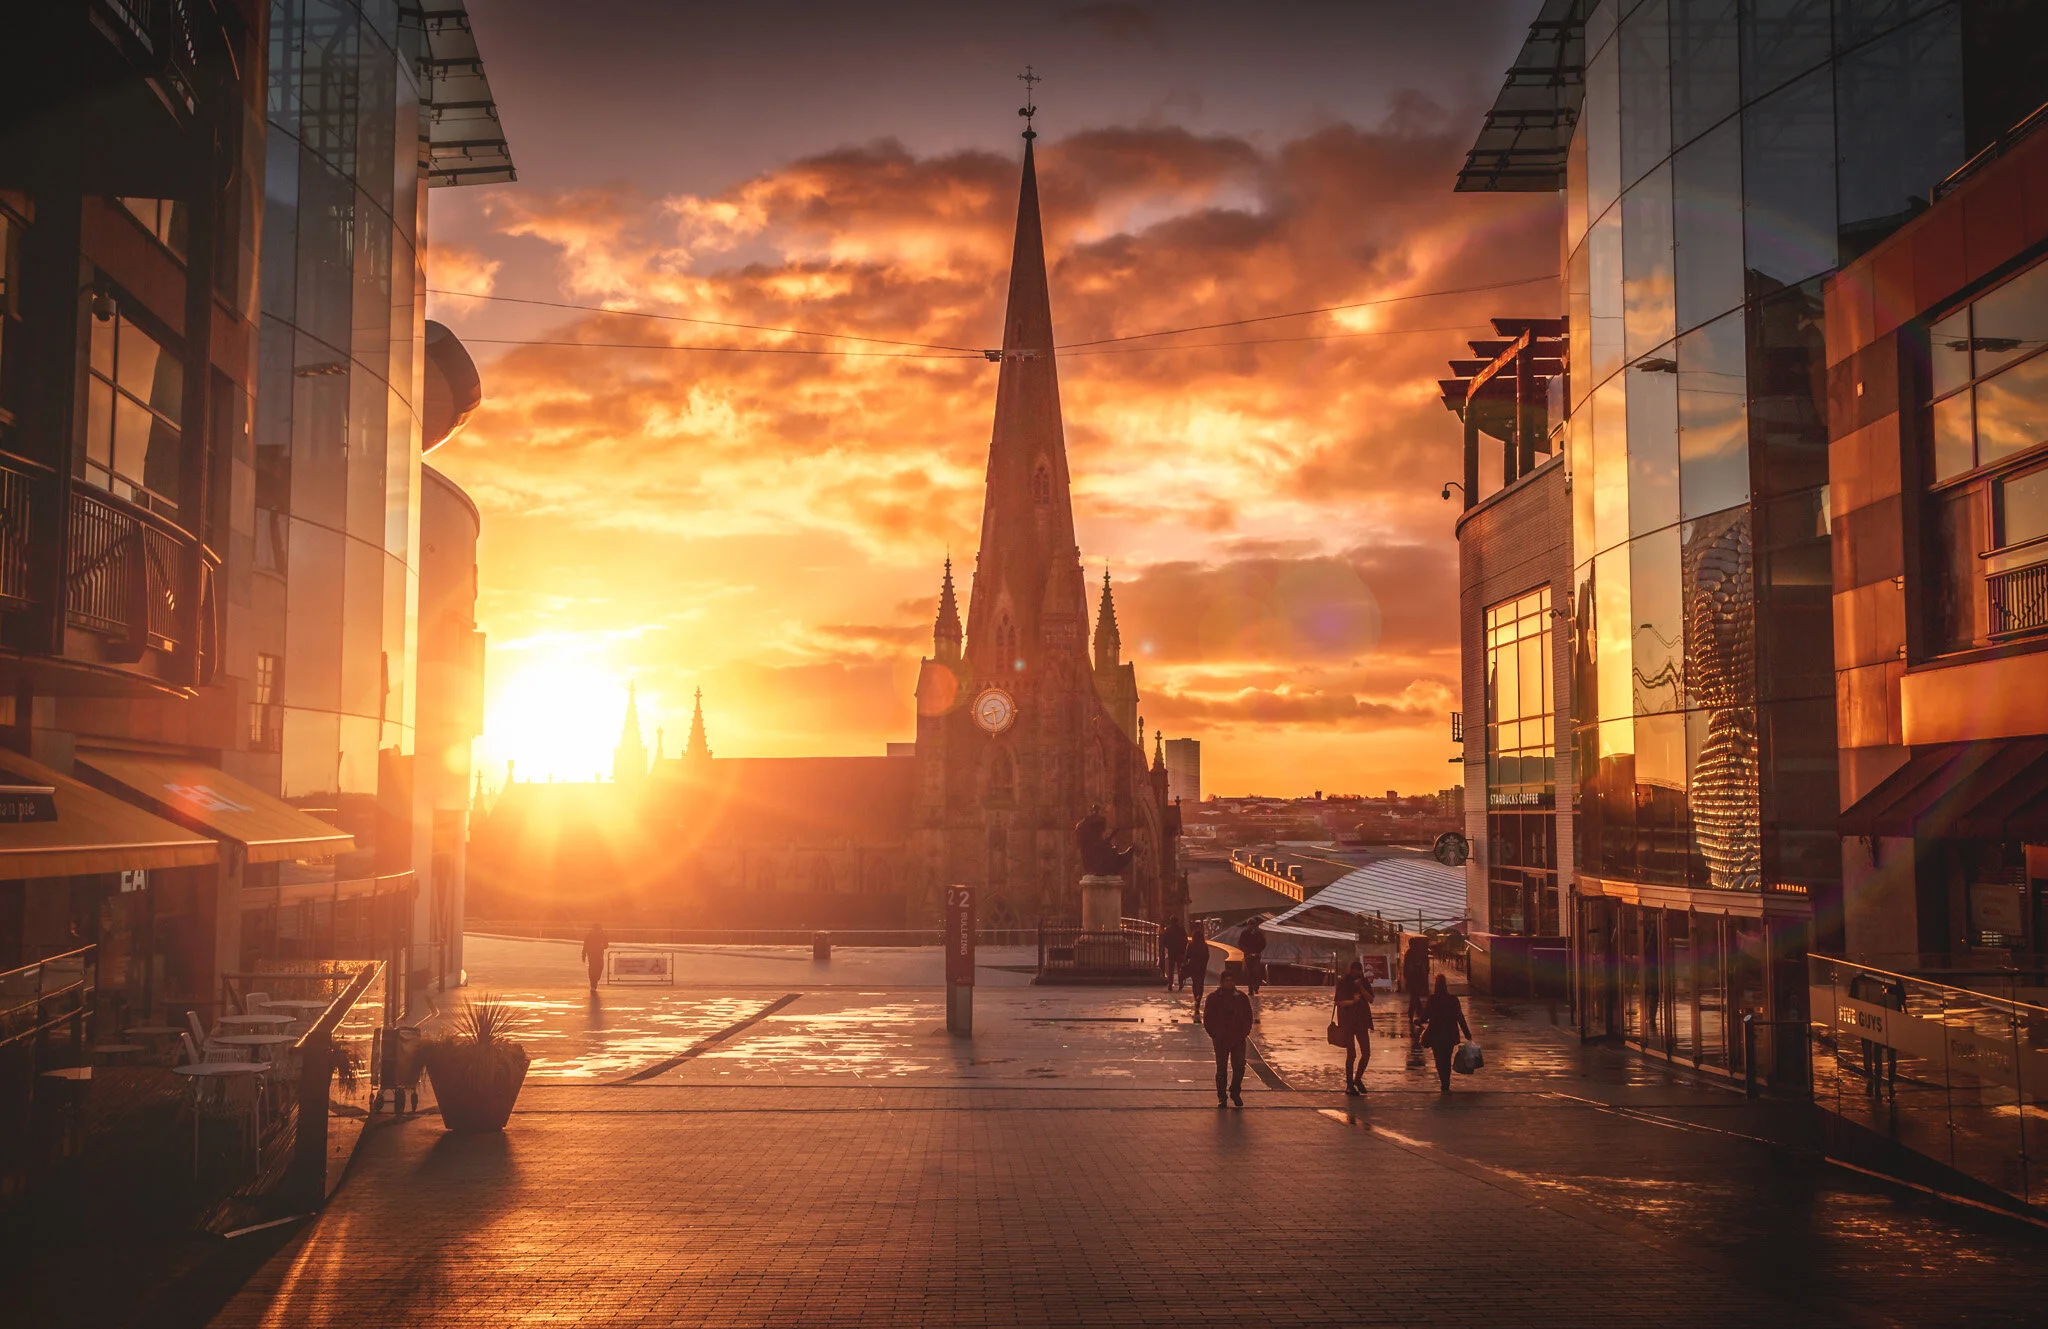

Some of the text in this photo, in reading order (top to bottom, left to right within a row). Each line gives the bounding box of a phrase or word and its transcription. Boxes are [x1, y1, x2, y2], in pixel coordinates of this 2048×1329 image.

[0, 796, 36, 822] an pie
[1489, 792, 1539, 805] STARBUCKS COFFEE
[959, 891, 970, 908] 2
[960, 912, 968, 956] BULLRING
[1838, 1004, 1883, 1034] FIVE GUYS
